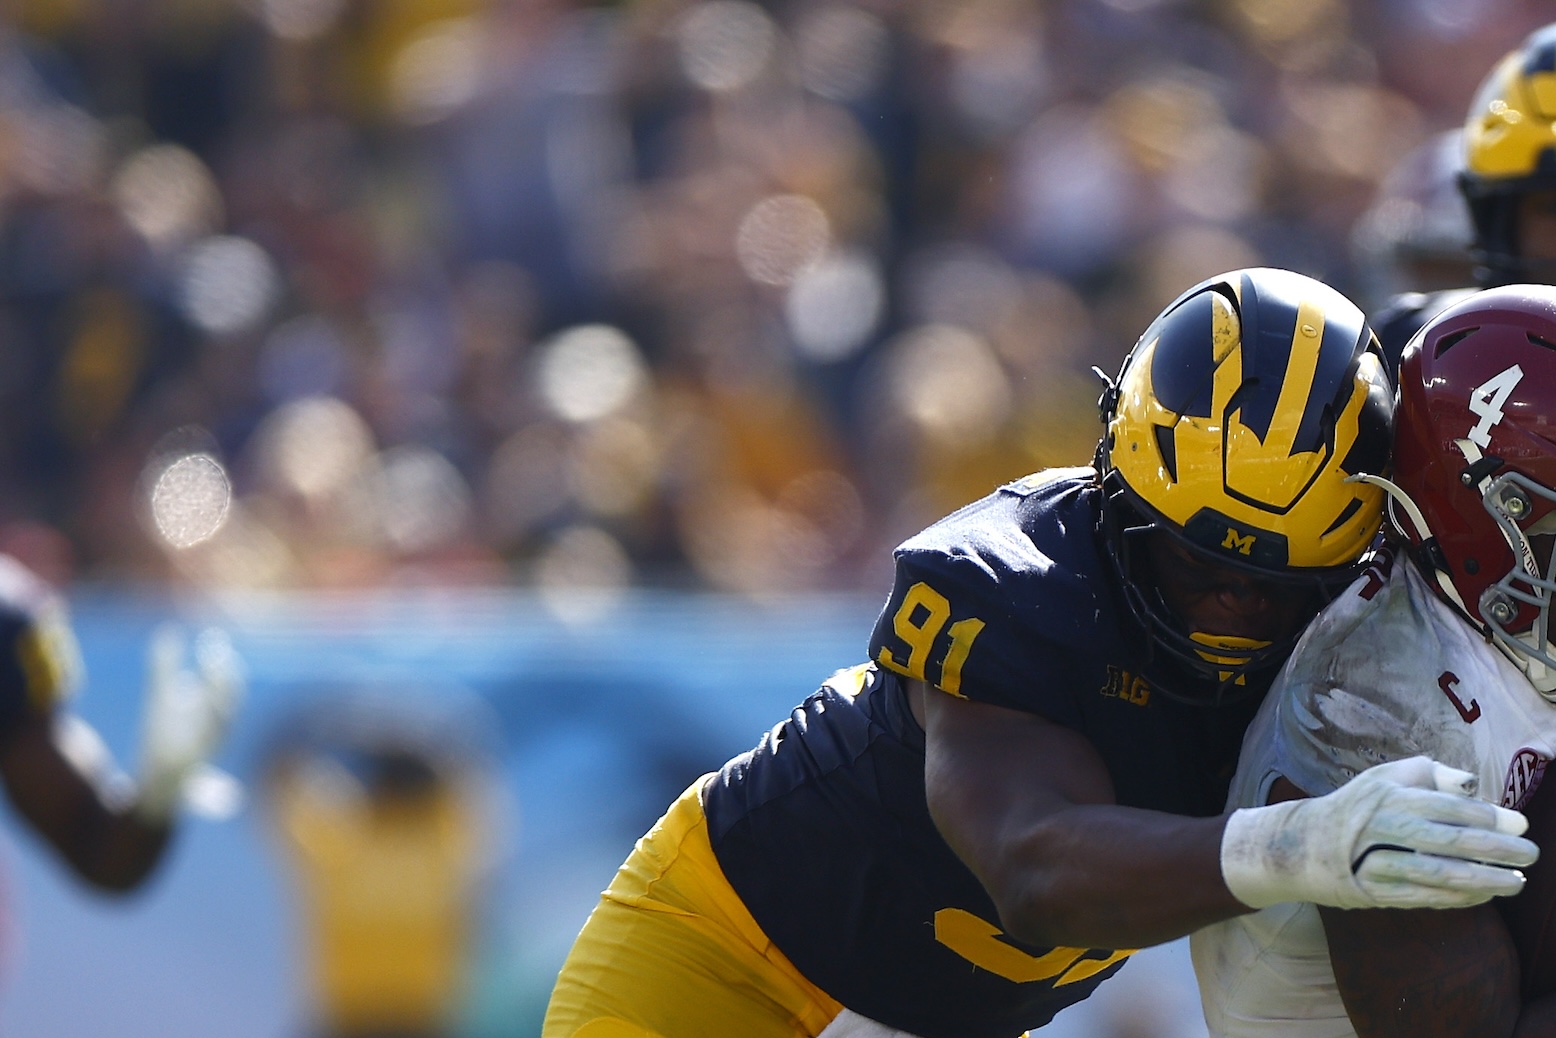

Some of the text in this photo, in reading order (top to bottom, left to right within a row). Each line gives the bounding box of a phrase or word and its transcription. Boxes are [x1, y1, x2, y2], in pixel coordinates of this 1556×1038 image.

[1467, 363, 1524, 449] 4
[1221, 527, 1256, 556] M
[878, 581, 985, 699] 91
[1438, 670, 1481, 724] C
[1503, 752, 1536, 808] SEC
